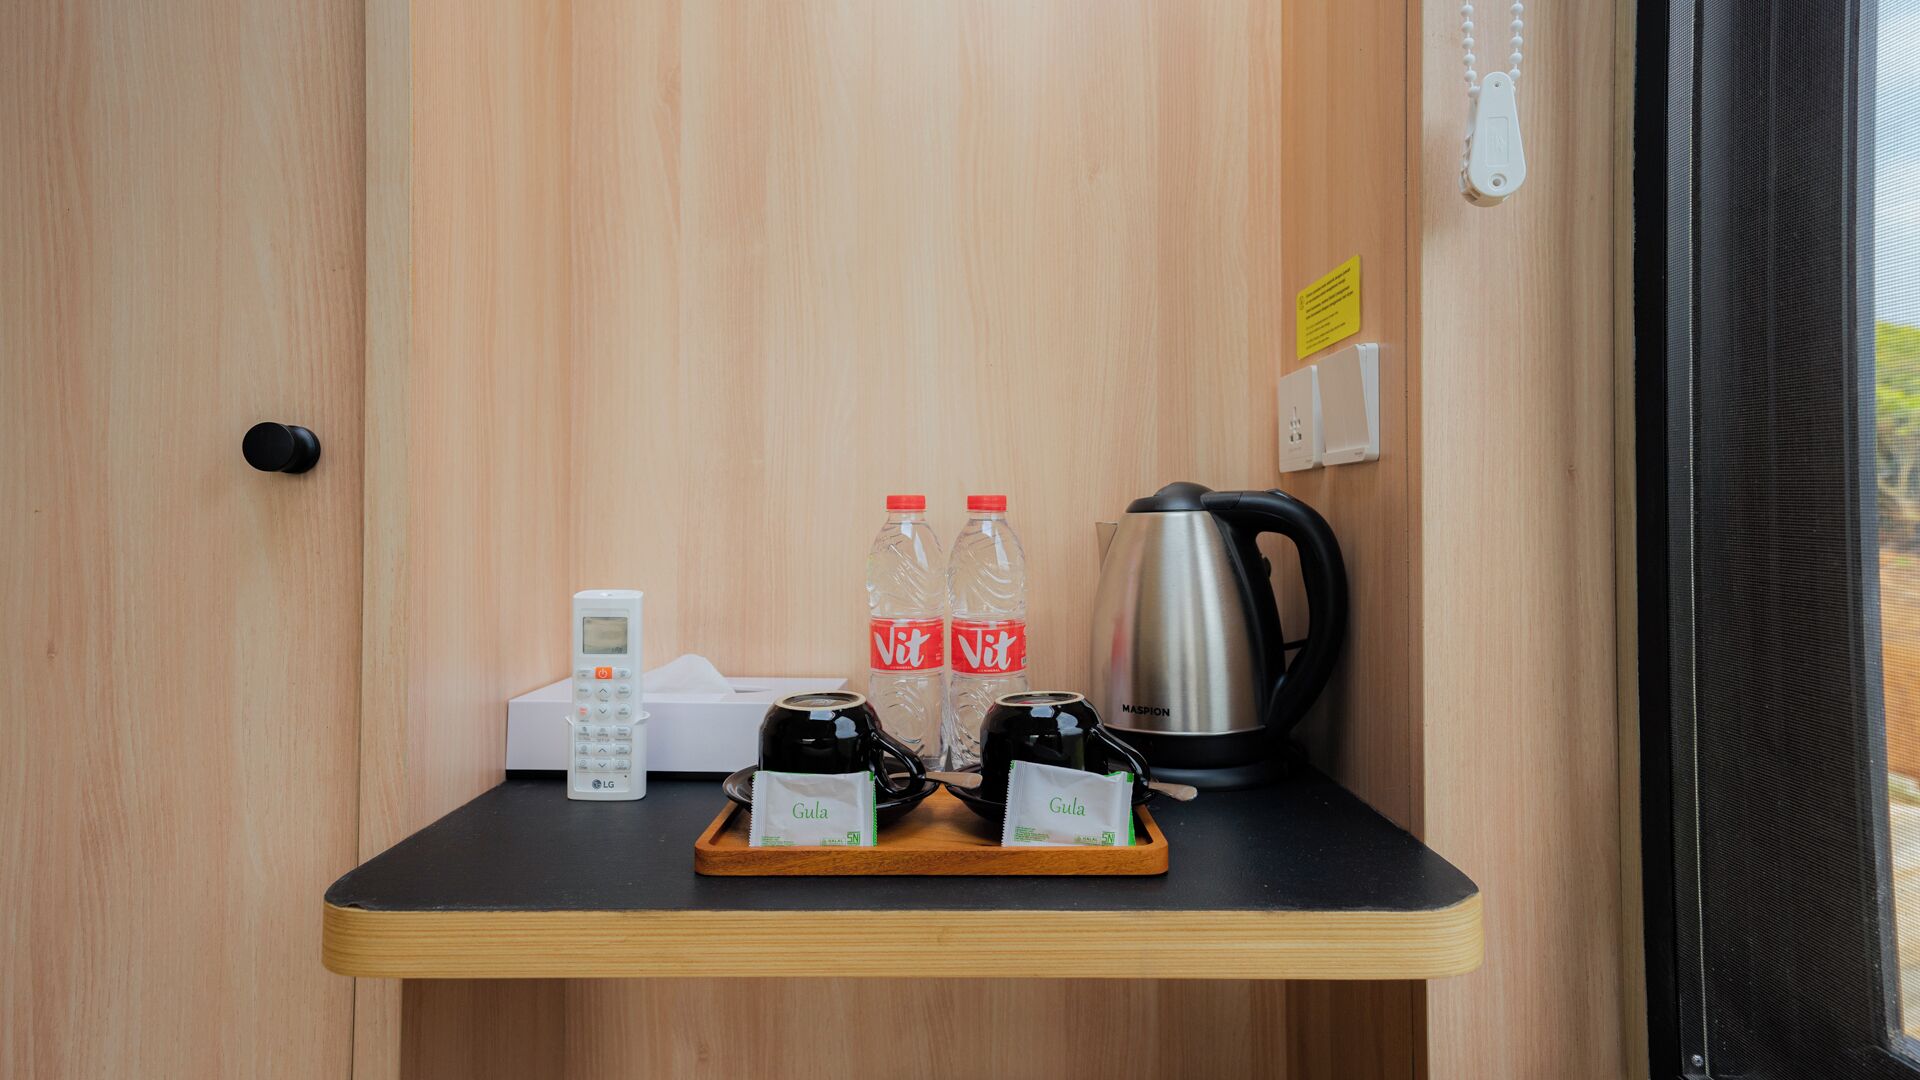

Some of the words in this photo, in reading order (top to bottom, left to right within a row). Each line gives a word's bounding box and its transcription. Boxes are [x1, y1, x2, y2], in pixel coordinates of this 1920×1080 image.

[873, 624, 931, 668] Vit
[958, 628, 1017, 670] Vit
[1122, 704, 1170, 717] MASPION
[792, 801, 829, 819] Gula
[1049, 796, 1086, 817] Gula
